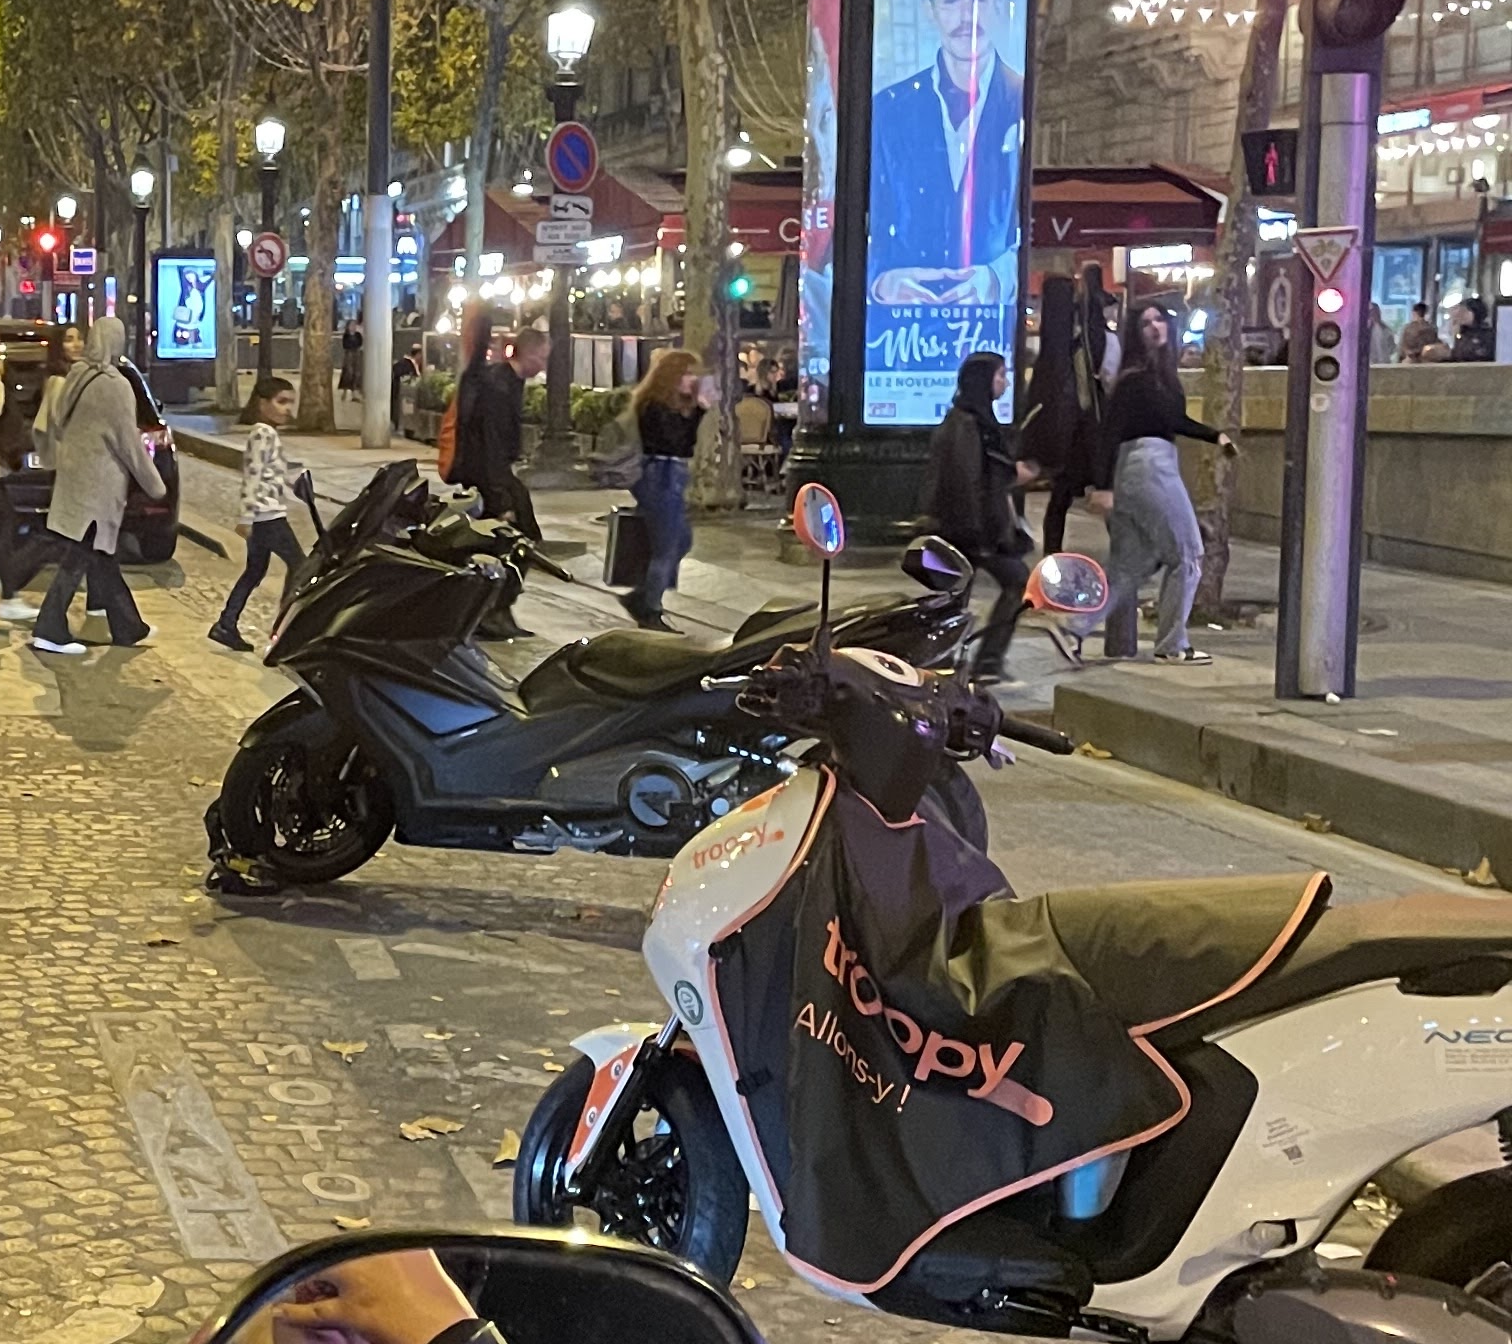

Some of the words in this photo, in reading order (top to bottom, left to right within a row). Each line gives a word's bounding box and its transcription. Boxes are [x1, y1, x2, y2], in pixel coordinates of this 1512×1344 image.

[891, 307, 922, 318] UNE
[793, 1002, 895, 1104] Allons-y
[823, 915, 1026, 1099] troopy
